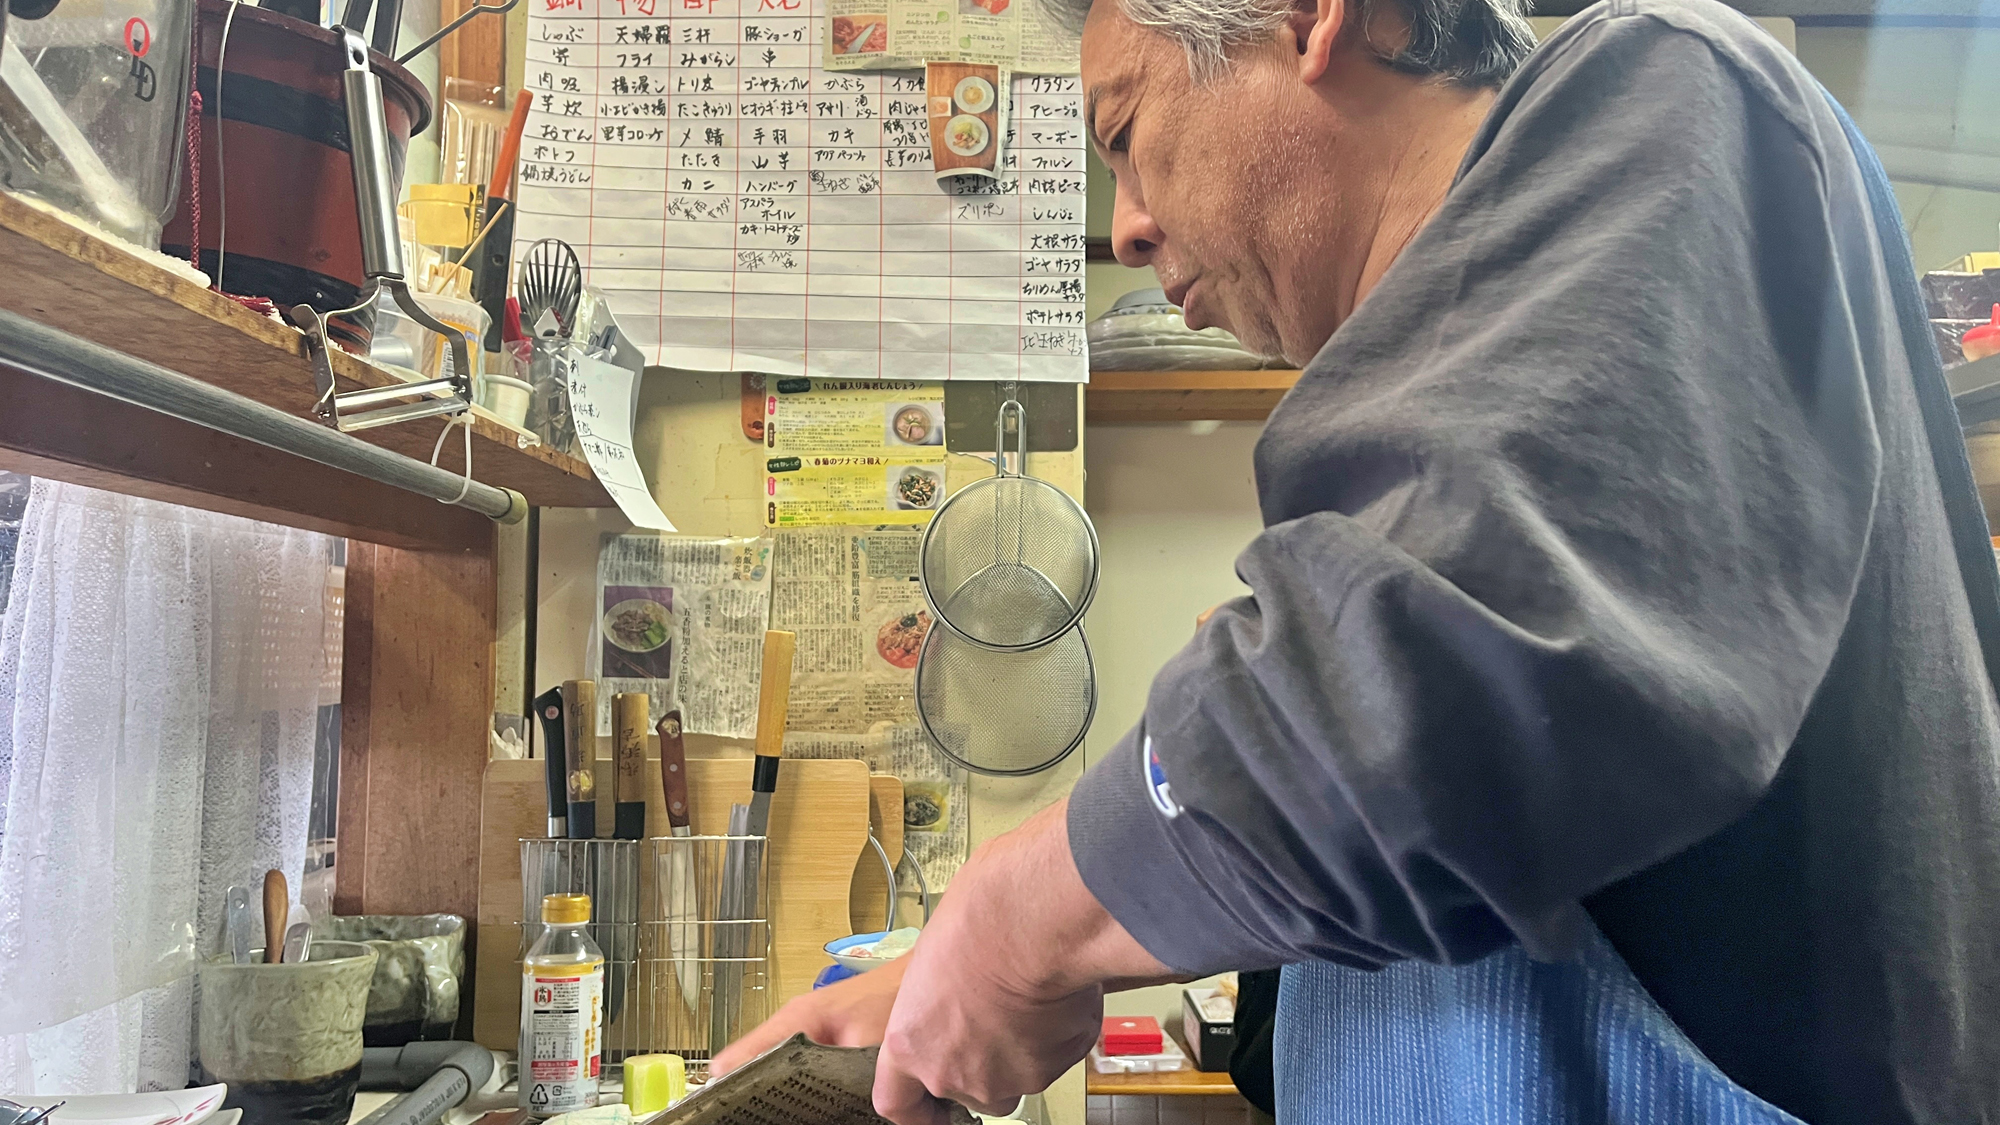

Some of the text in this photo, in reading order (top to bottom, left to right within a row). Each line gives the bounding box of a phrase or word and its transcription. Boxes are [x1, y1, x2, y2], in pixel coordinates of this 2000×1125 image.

[745, 25, 807, 42] 豚ショーガ
[617, 52, 653, 68] フライ
[824, 77, 865, 92] かぶら
[1031, 75, 1075, 93] グラタン
[677, 100, 732, 118] たこきゅうり
[1029, 101, 1078, 119] アヒージョ
[540, 125, 593, 142] おでん
[601, 125, 664, 142] 里芋コロッケ
[753, 127, 787, 145] 手羽
[827, 127, 855, 145] カキ
[1031, 130, 1078, 145] マーボー
[534, 145, 575, 162] ポトフ
[681, 152, 721, 168] たたき
[751, 151, 790, 170] 山芋
[681, 177, 715, 191] カニ
[745, 179, 798, 193] ハンバーグ
[739, 197, 775, 210] アスパラ
[761, 210, 796, 221] オイル
